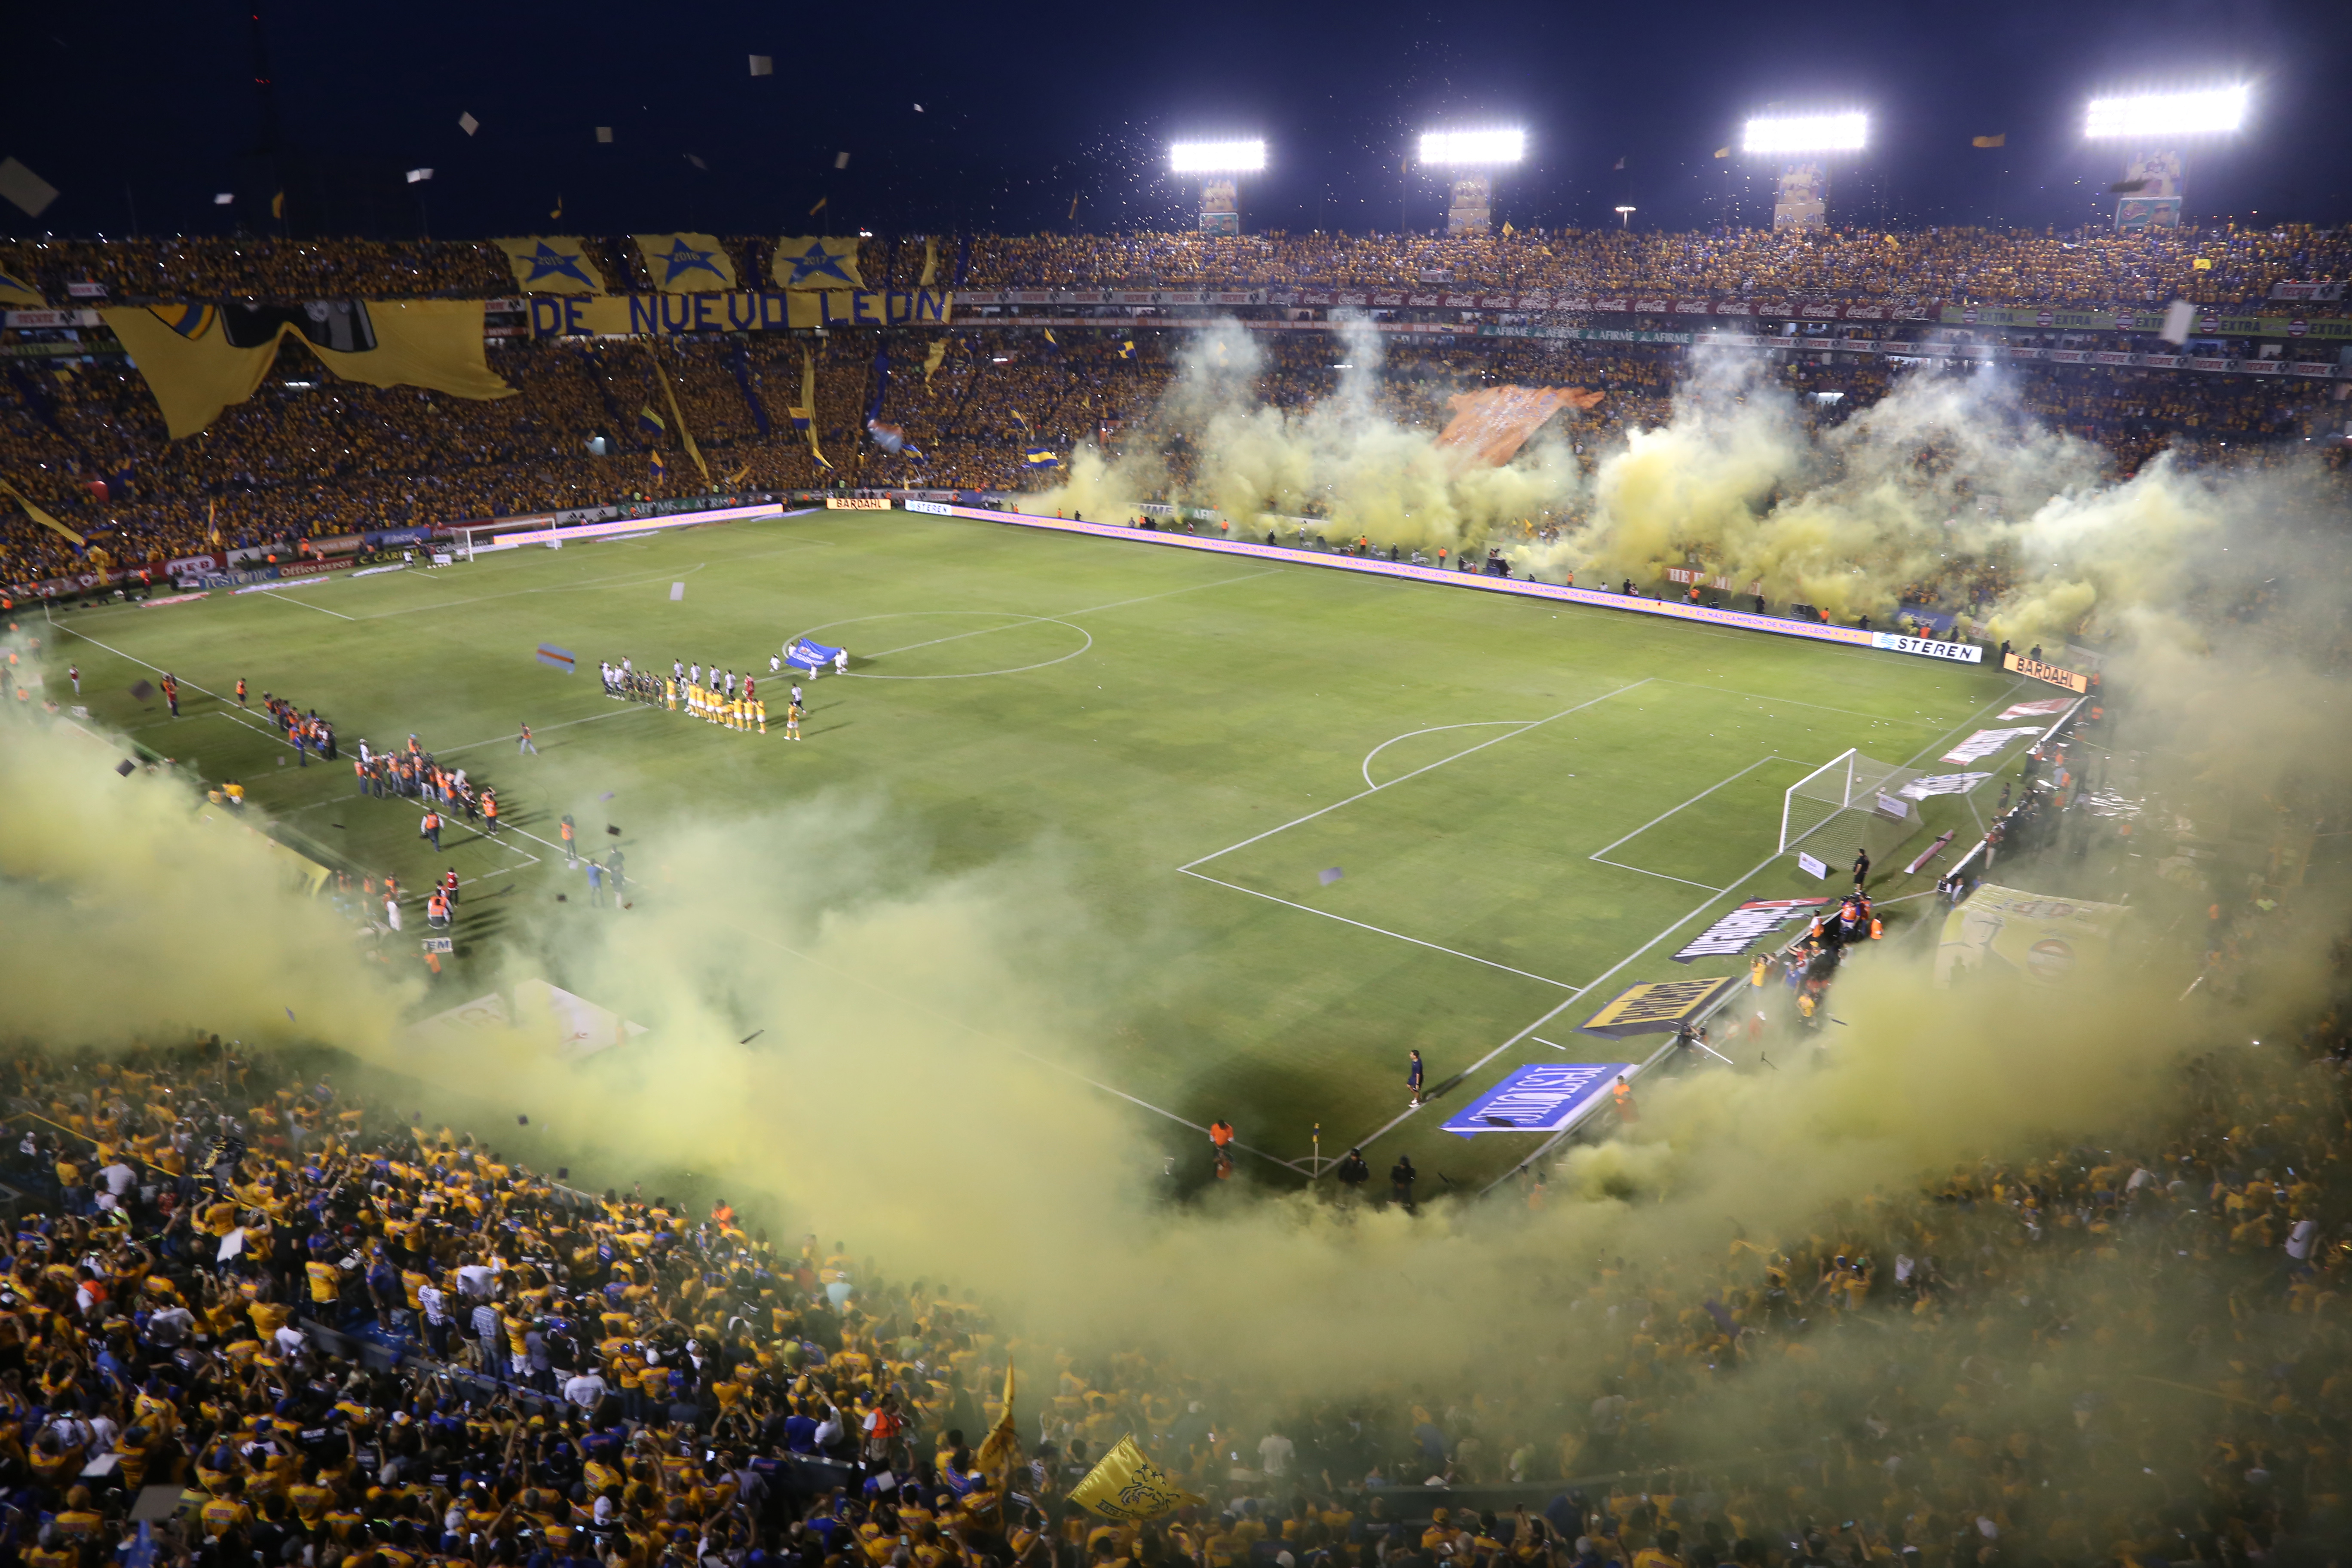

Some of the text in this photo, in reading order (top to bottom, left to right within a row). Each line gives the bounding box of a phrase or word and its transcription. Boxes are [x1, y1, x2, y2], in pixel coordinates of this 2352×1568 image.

[2282, 287, 2316, 297] TECATE
[530, 291, 948, 339] DE NUEVO LEON
[1635, 300, 1668, 312] Coca-Cola
[1675, 301, 1709, 314] Coca-Cola
[1716, 302, 1751, 315] Coca-Cola
[1759, 302, 1795, 315] Coca-Cola
[1802, 303, 1839, 318] Coca-Cola
[1846, 305, 1883, 319] Coca-Cola
[2055, 315, 2091, 325] EXTRA
[2221, 320, 2261, 332] EXTRA
[2309, 323, 2352, 335] EXTRA
[1495, 326, 1529, 336] AFIRME
[1599, 331, 1635, 341] AFIRME
[1653, 333, 1690, 343] AFIRME
[2196, 359, 2224, 369] TECATE
[2246, 361, 2275, 371] TECATE
[2297, 364, 2328, 374] TECATE
[836, 498, 882, 510] BARDAHL
[917, 502, 949, 514] STEREN
[279, 560, 354, 577] Office DEPOT
[1409, 568, 1430, 576] NUEVO
[1581, 593, 1605, 602] NUEVO
[1708, 611, 1723, 619] MÁS
[1725, 614, 1763, 625] CAMPEÓN
[1779, 622, 1806, 632] NUEVO
[1808, 627, 1831, 636] LEÓN
[1897, 638, 1973, 659] STEREN
[2016, 657, 2074, 689] BARDAHL
[1608, 980, 1720, 1024] BARDAHL
